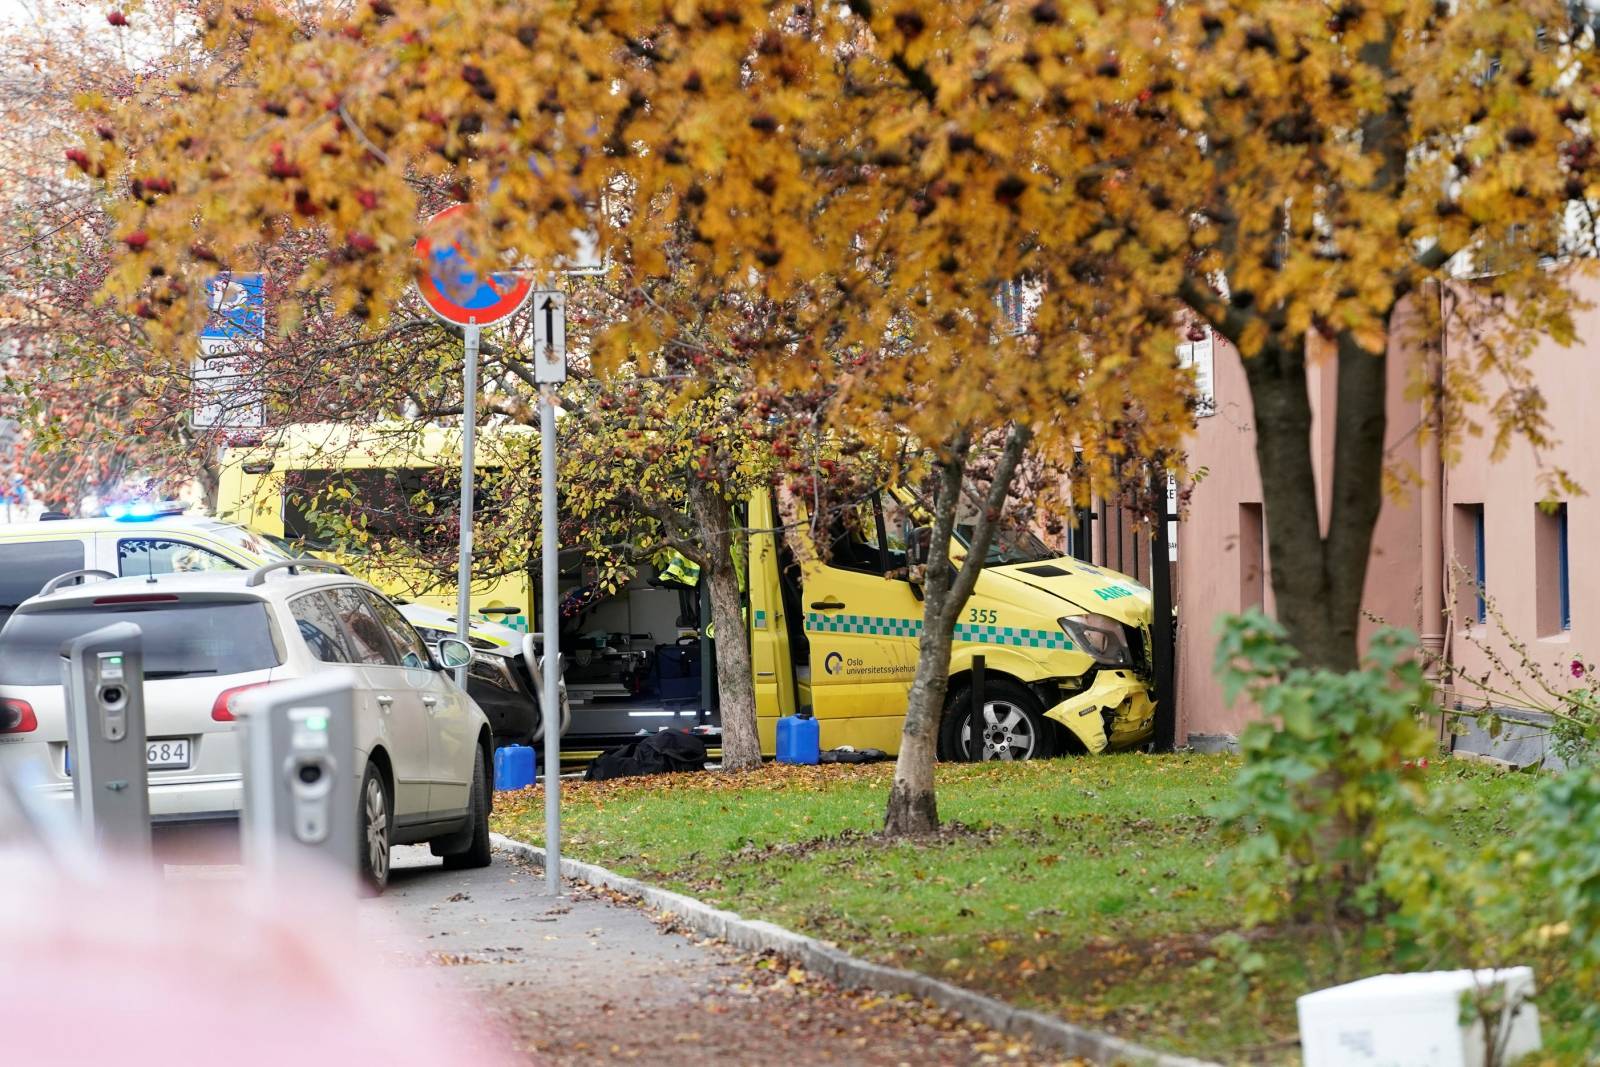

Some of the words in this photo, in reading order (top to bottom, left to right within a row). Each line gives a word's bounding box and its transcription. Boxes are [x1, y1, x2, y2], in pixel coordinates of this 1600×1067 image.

[969, 608, 998, 624] 355
[846, 658, 863, 666] Oslo
[147, 743, 184, 761] 684
